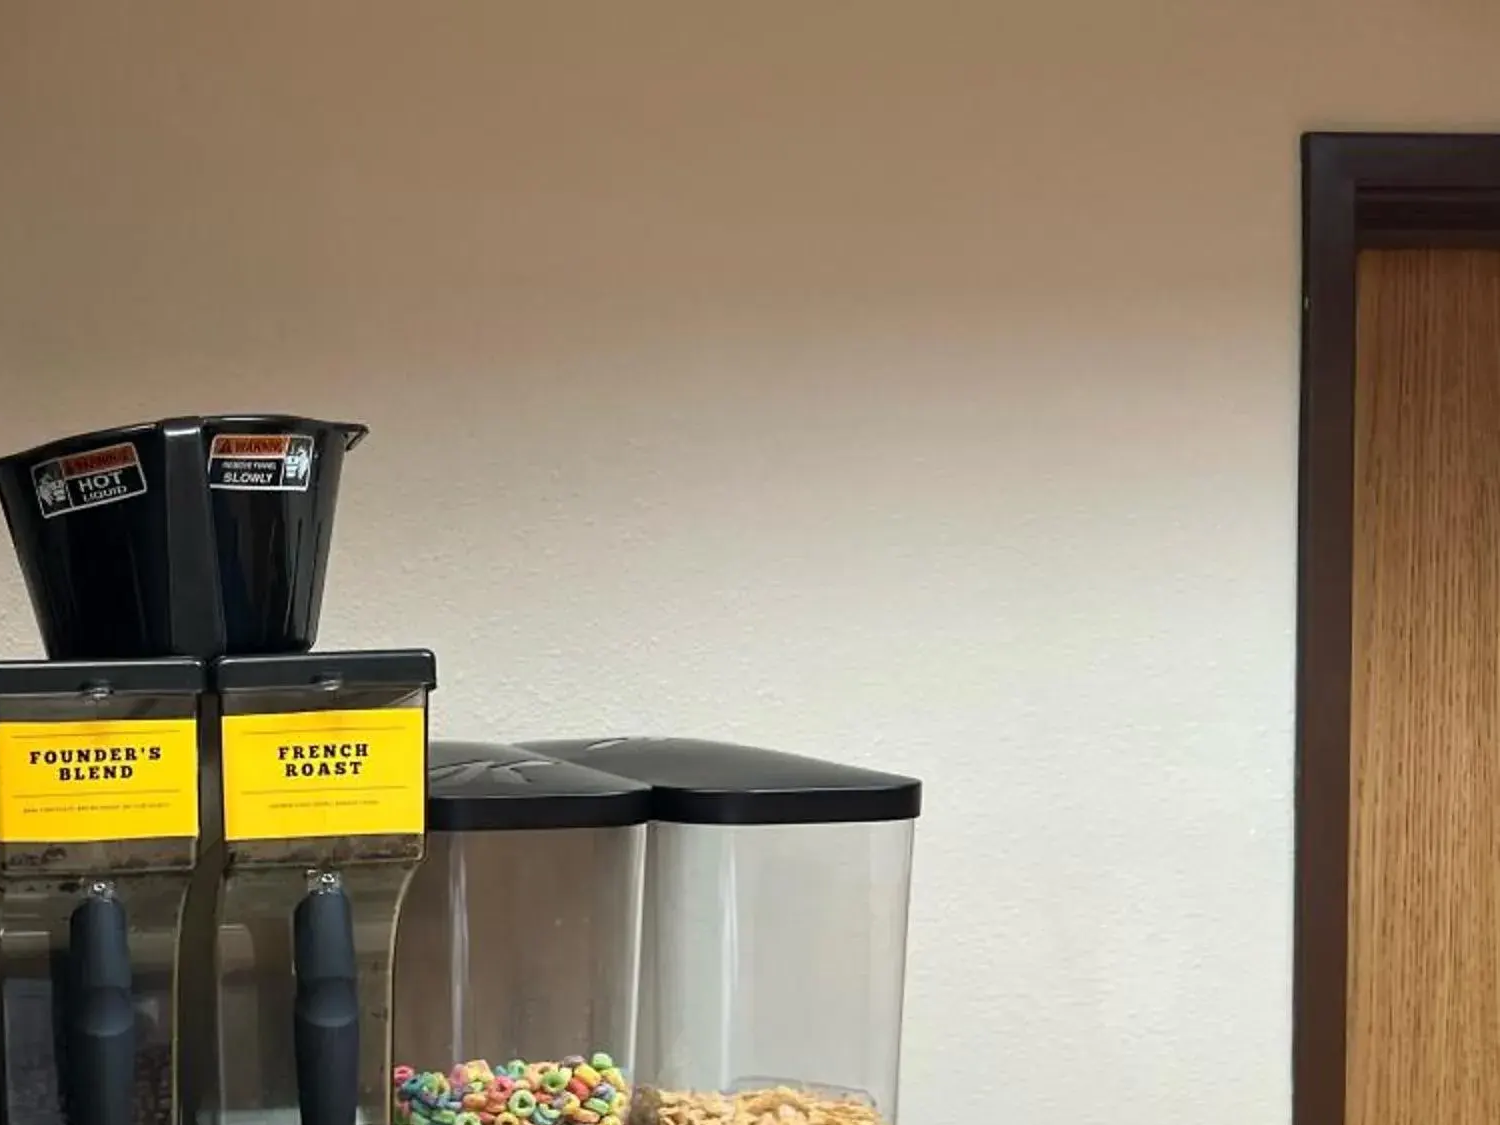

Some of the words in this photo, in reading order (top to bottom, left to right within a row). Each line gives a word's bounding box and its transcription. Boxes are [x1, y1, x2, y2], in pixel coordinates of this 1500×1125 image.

[78, 470, 124, 493] HOT
[223, 472, 273, 484] SLOWLY
[29, 746, 162, 767] FOUNDER'S
[278, 743, 370, 761] FRENCH
[58, 765, 135, 781] BLEND
[285, 762, 363, 778] ROAST
